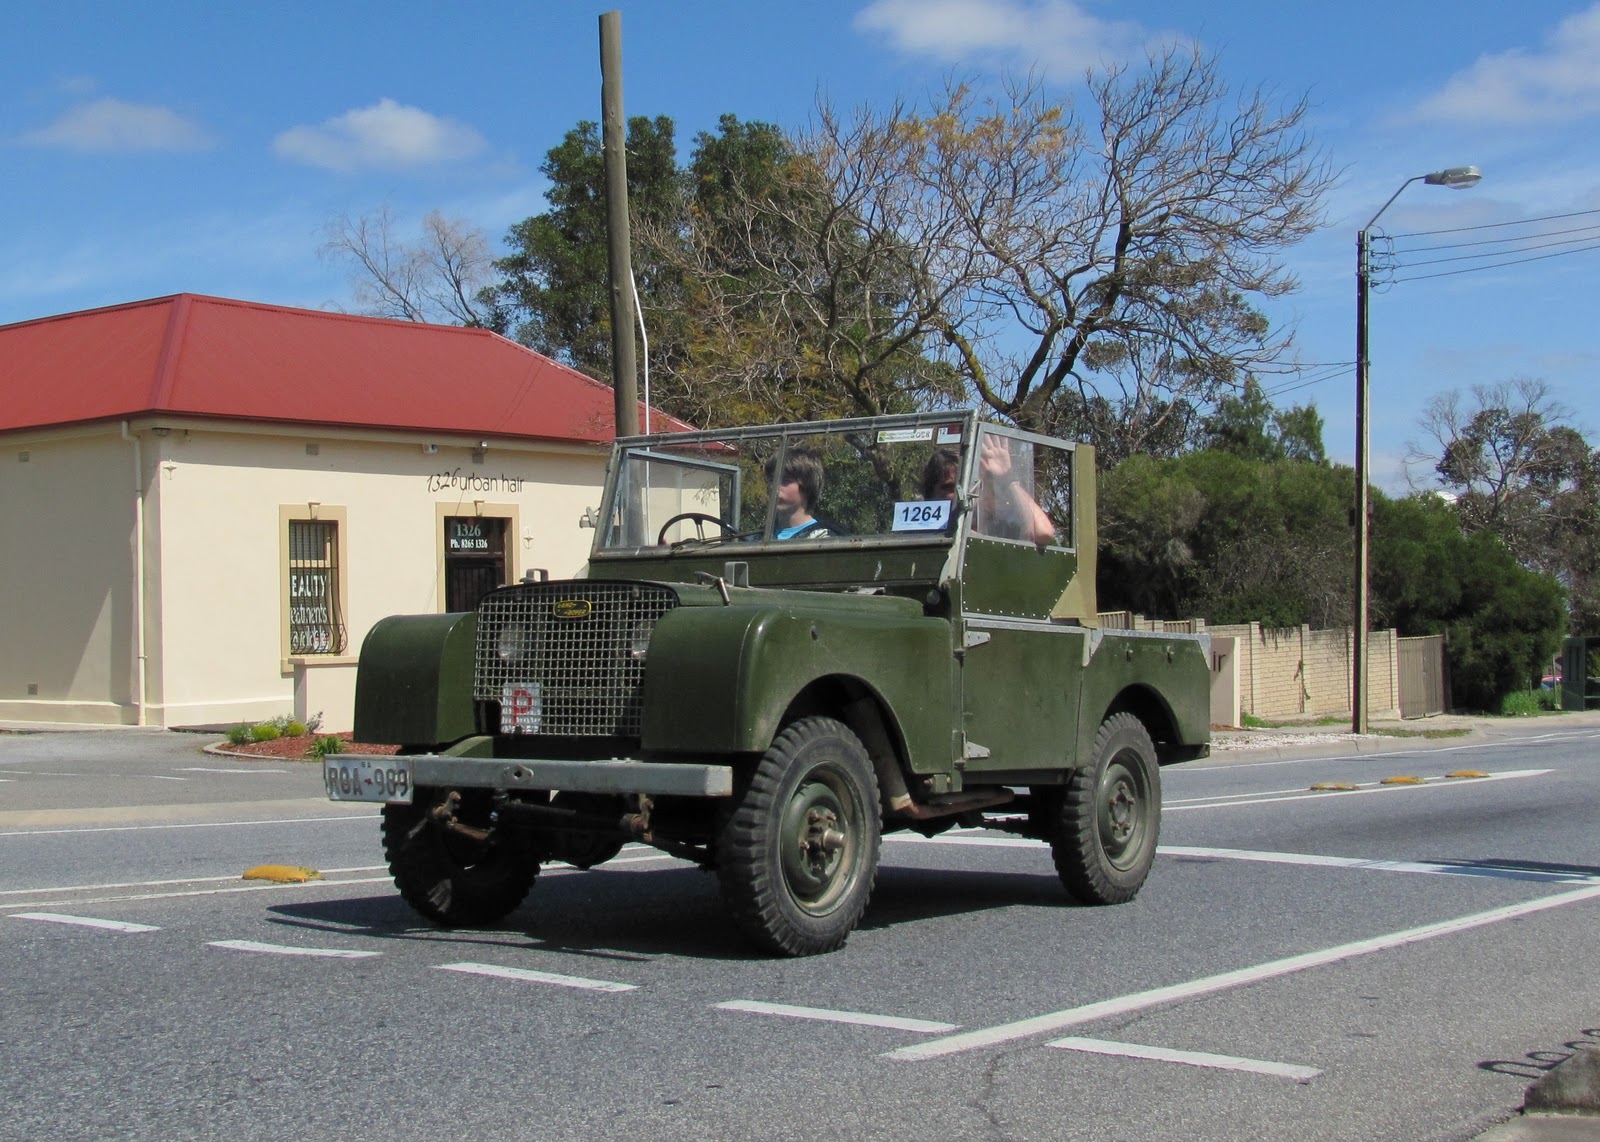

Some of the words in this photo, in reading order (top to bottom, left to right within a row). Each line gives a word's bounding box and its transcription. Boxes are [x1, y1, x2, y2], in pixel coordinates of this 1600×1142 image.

[427, 468, 461, 493] 1326
[460, 472, 498, 491] urban
[501, 474, 524, 492] hair
[902, 506, 942, 522] 1264
[456, 524, 481, 537] 1326
[461, 539, 475, 549] 8265
[475, 539, 488, 549] 1326
[291, 575, 327, 597] EAUTY
